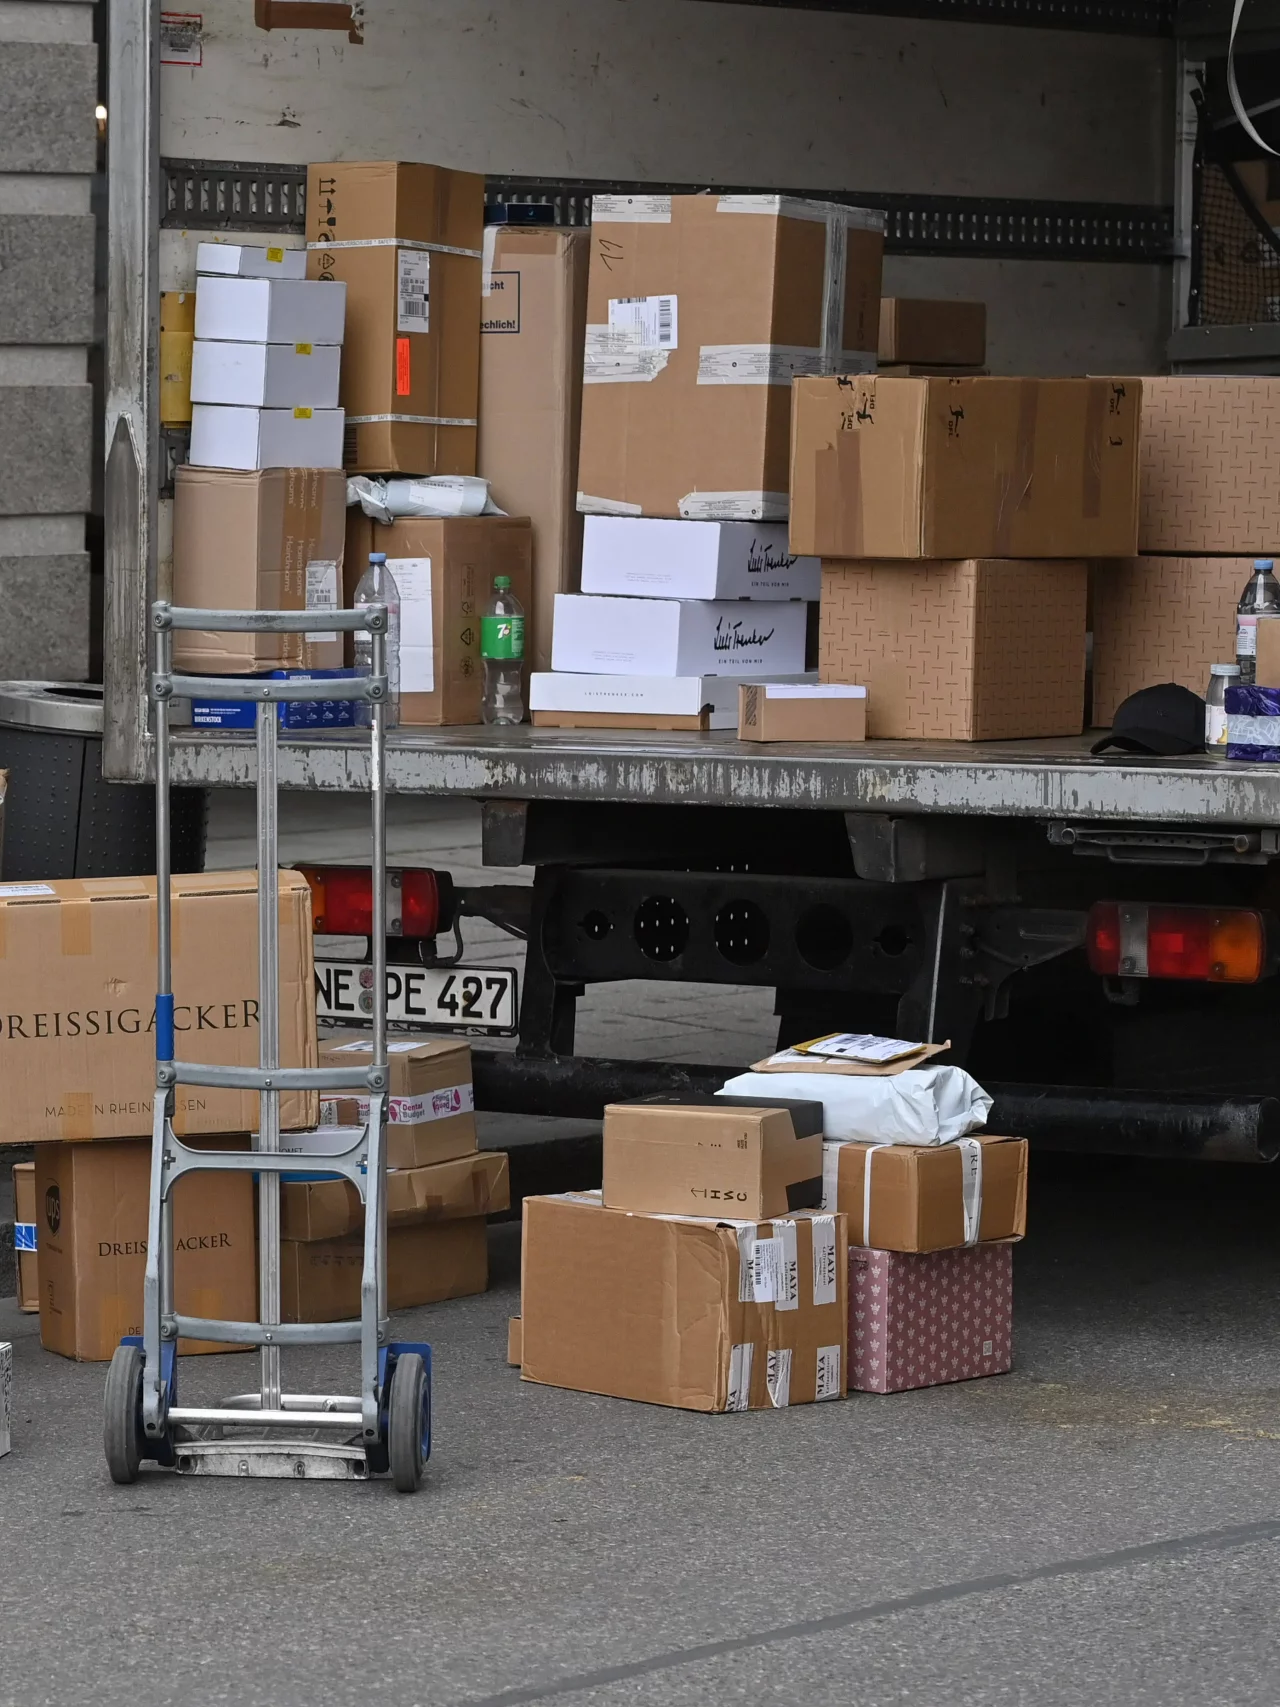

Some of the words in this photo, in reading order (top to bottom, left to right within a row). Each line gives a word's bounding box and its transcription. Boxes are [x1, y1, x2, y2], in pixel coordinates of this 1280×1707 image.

[284, 535, 294, 592] Hairdreams
[437, 975, 508, 1019] 427
[110, 1099, 206, 1114] RHEINSEN
[402, 1102, 424, 1112] Dental
[403, 1109, 426, 1120] Budget
[789, 1261, 797, 1301] MAYA
[827, 1245, 835, 1286] MAYA
[817, 1355, 826, 1395] MAYA
